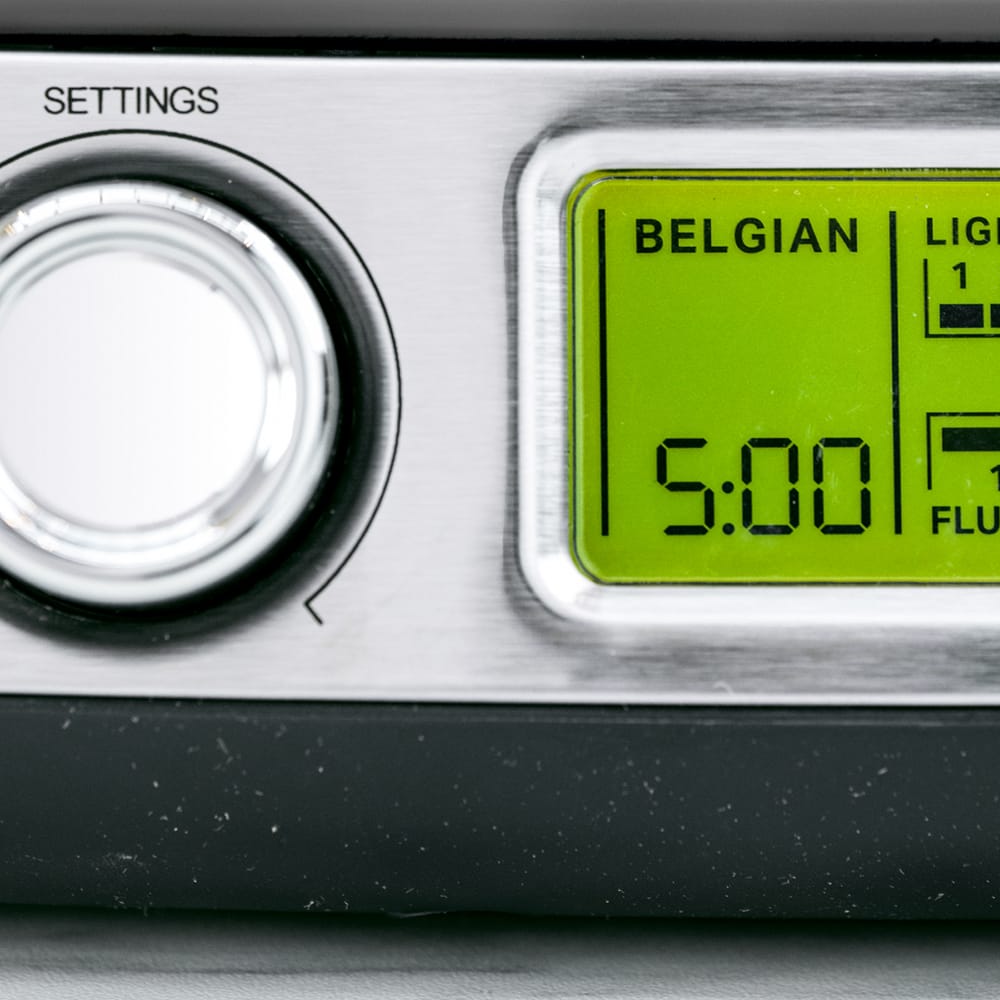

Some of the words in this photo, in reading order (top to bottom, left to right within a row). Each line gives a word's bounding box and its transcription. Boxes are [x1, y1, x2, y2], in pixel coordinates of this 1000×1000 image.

[44, 86, 218, 114] SETTINGS
[636, 218, 857, 253] BELGIAN
[953, 262, 966, 289] 1
[656, 438, 871, 536] 5:00
